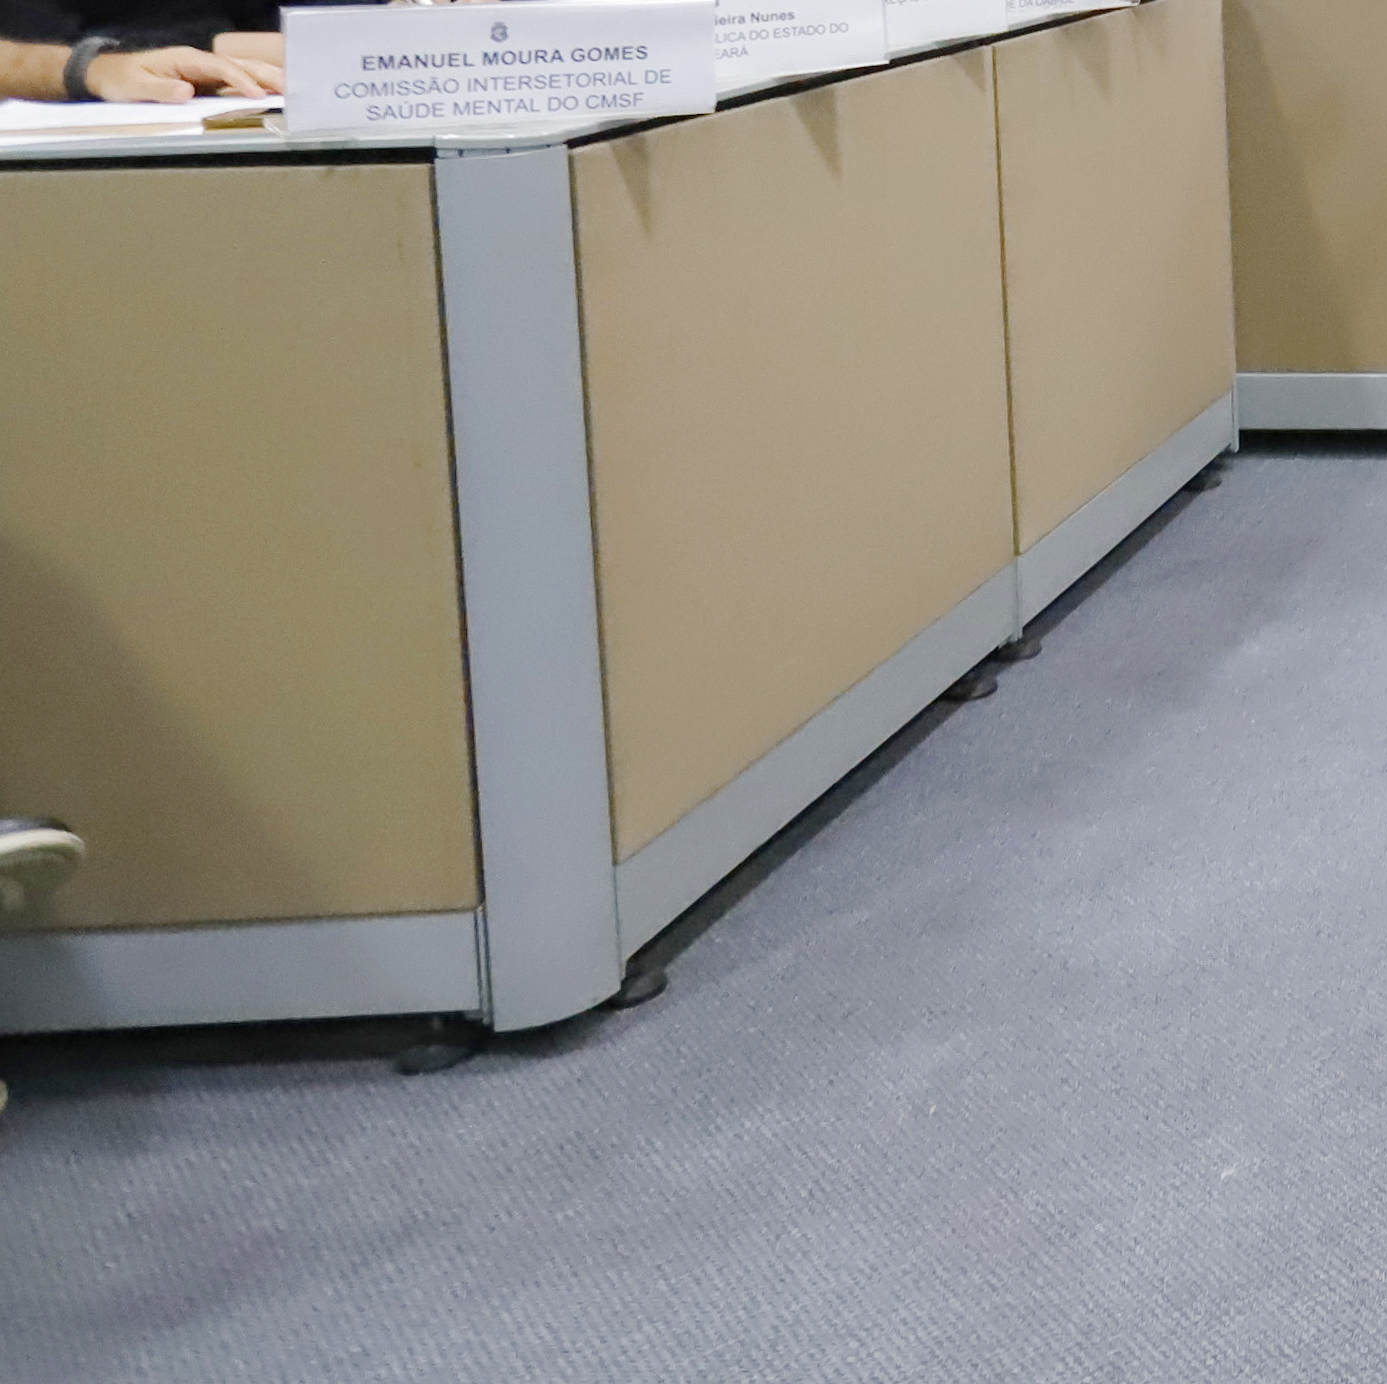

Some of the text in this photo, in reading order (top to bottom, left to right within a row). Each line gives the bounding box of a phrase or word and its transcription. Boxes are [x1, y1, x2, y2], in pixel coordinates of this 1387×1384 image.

[750, 11, 795, 24] Nunes
[750, 29, 769, 41] DO
[773, 24, 826, 39] ESTADO
[830, 22, 849, 33] DO
[362, 45, 648, 71] EMANUEL MOURA GOMES
[334, 69, 672, 99] COMISSÃO INTERSETORIAL DE
[366, 92, 645, 121] SAÚDE MENTAL DO CMSF
